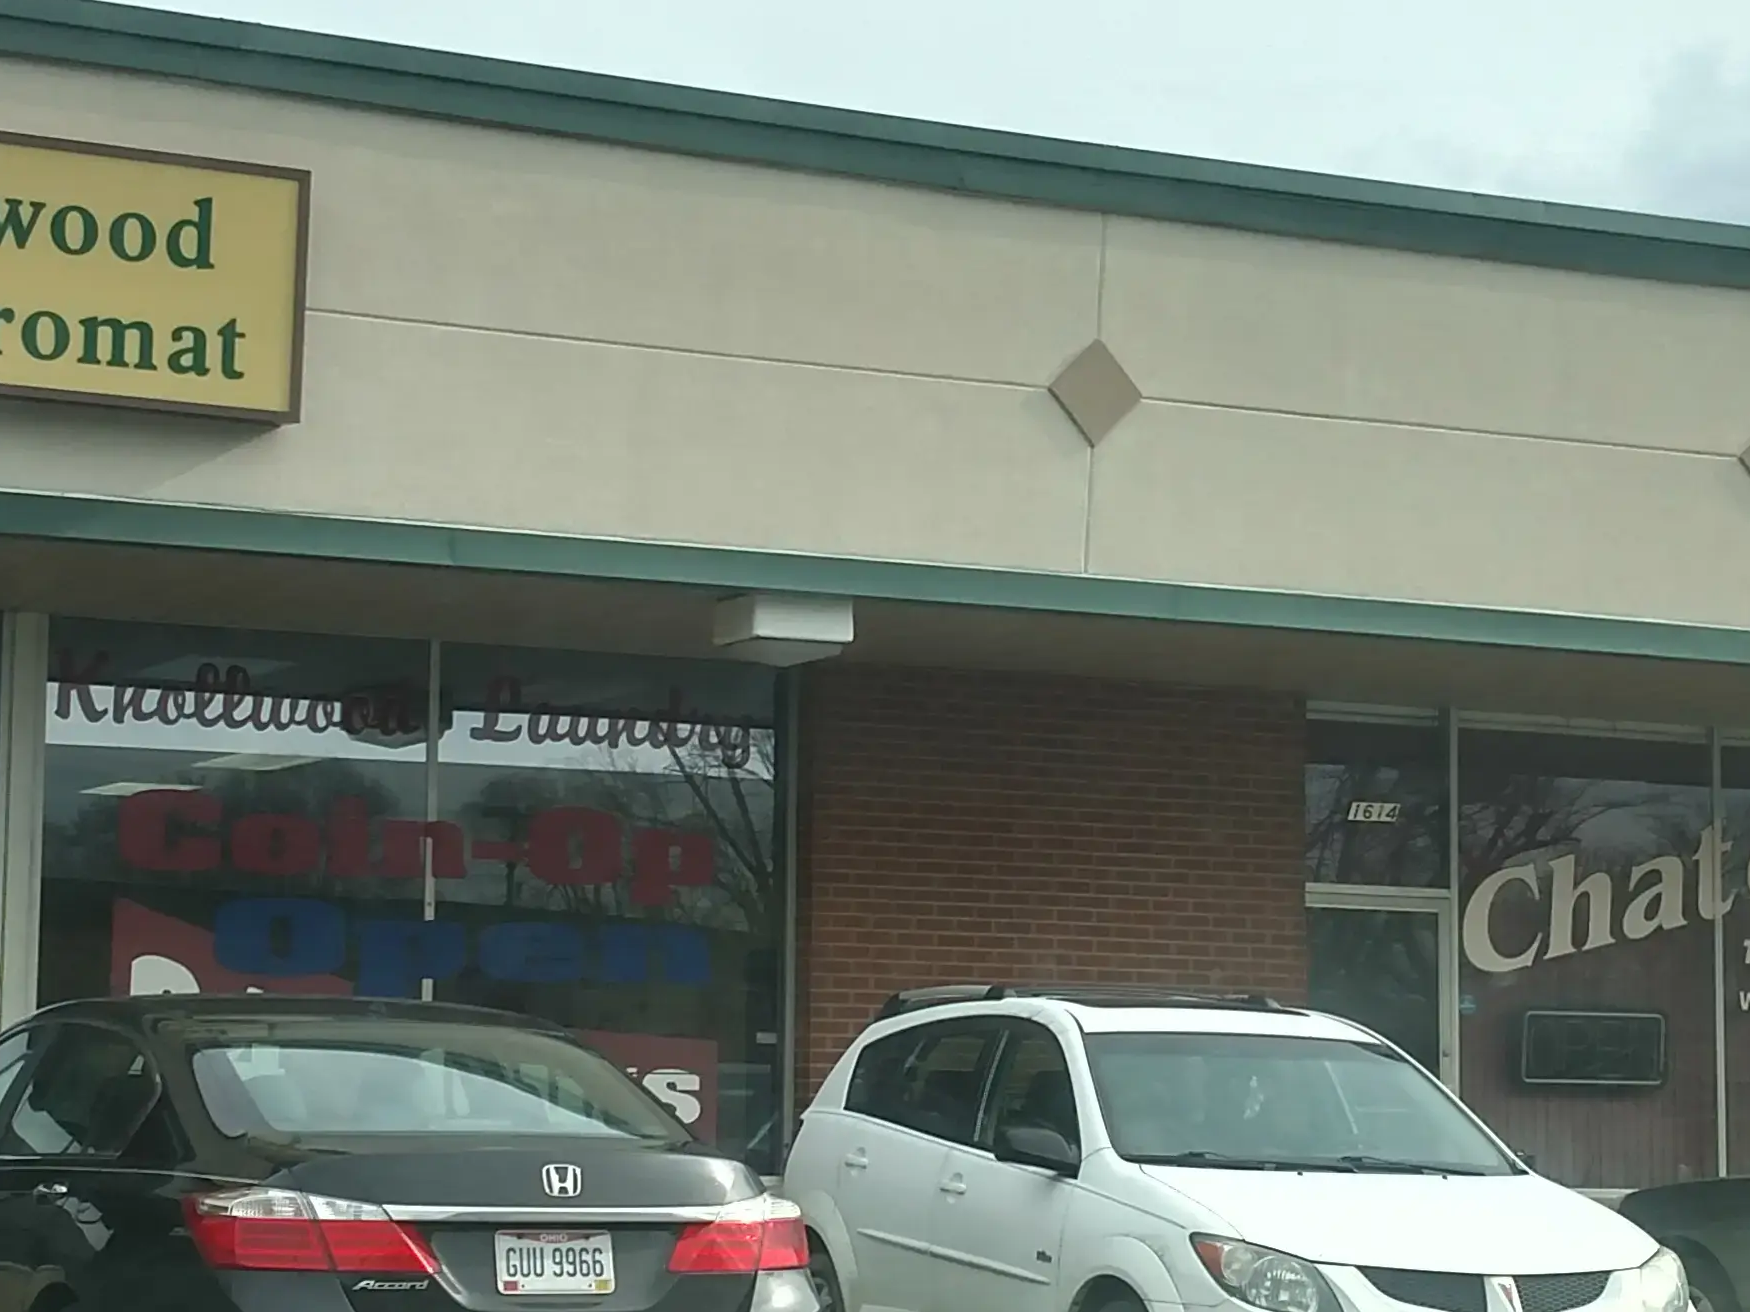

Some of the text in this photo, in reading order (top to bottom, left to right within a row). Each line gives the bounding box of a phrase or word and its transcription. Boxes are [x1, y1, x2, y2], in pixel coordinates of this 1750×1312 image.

[469, 675, 752, 769] Laundry
[1353, 803, 1399, 820] 1614
[118, 789, 714, 907] Coin-Op
[214, 896, 712, 1000] Open
[539, 1233, 569, 1243] OHIO
[505, 1246, 604, 1278] GUU 9966
[352, 1279, 430, 1291] Accord
